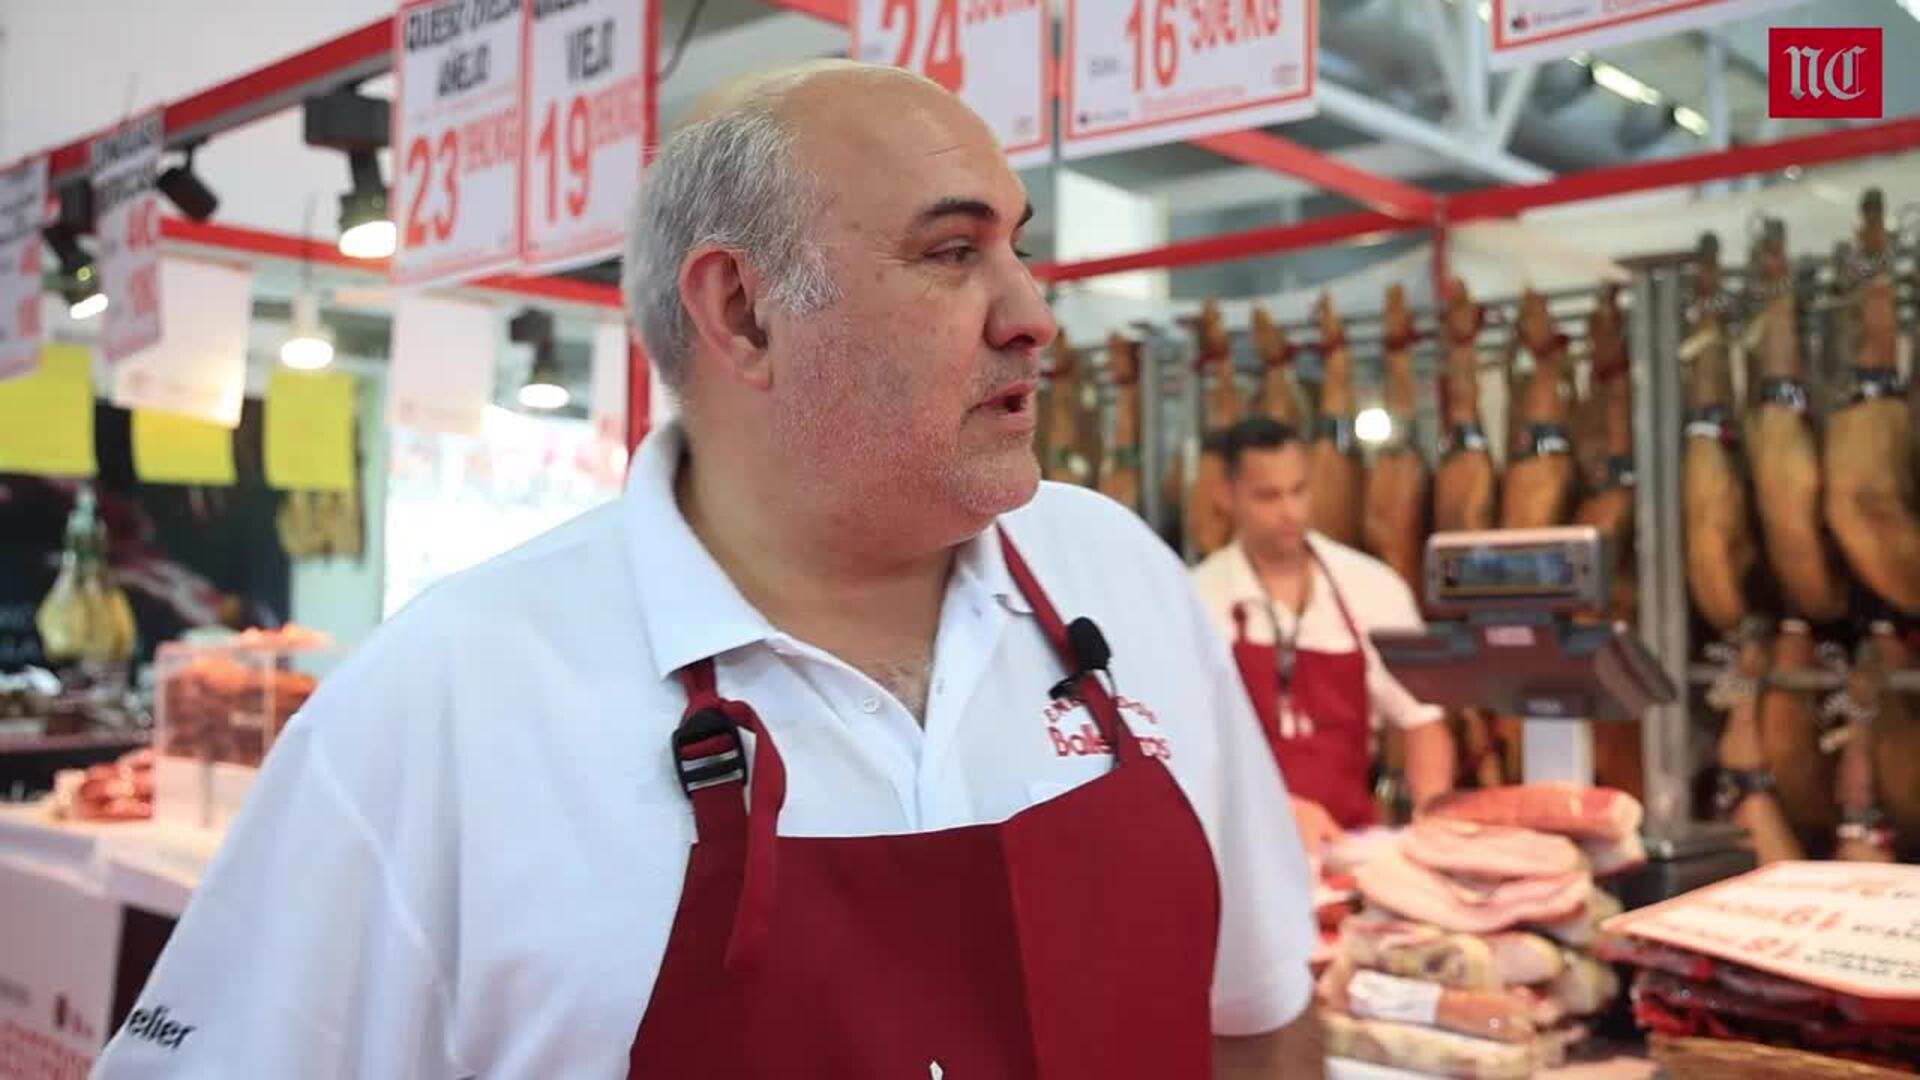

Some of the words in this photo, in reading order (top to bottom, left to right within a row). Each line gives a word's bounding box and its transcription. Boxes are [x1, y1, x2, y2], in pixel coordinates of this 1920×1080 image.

[878, 0, 965, 95] 24
[1124, 0, 1178, 94] 16
[404, 130, 460, 248] 23
[537, 95, 592, 223] 19
